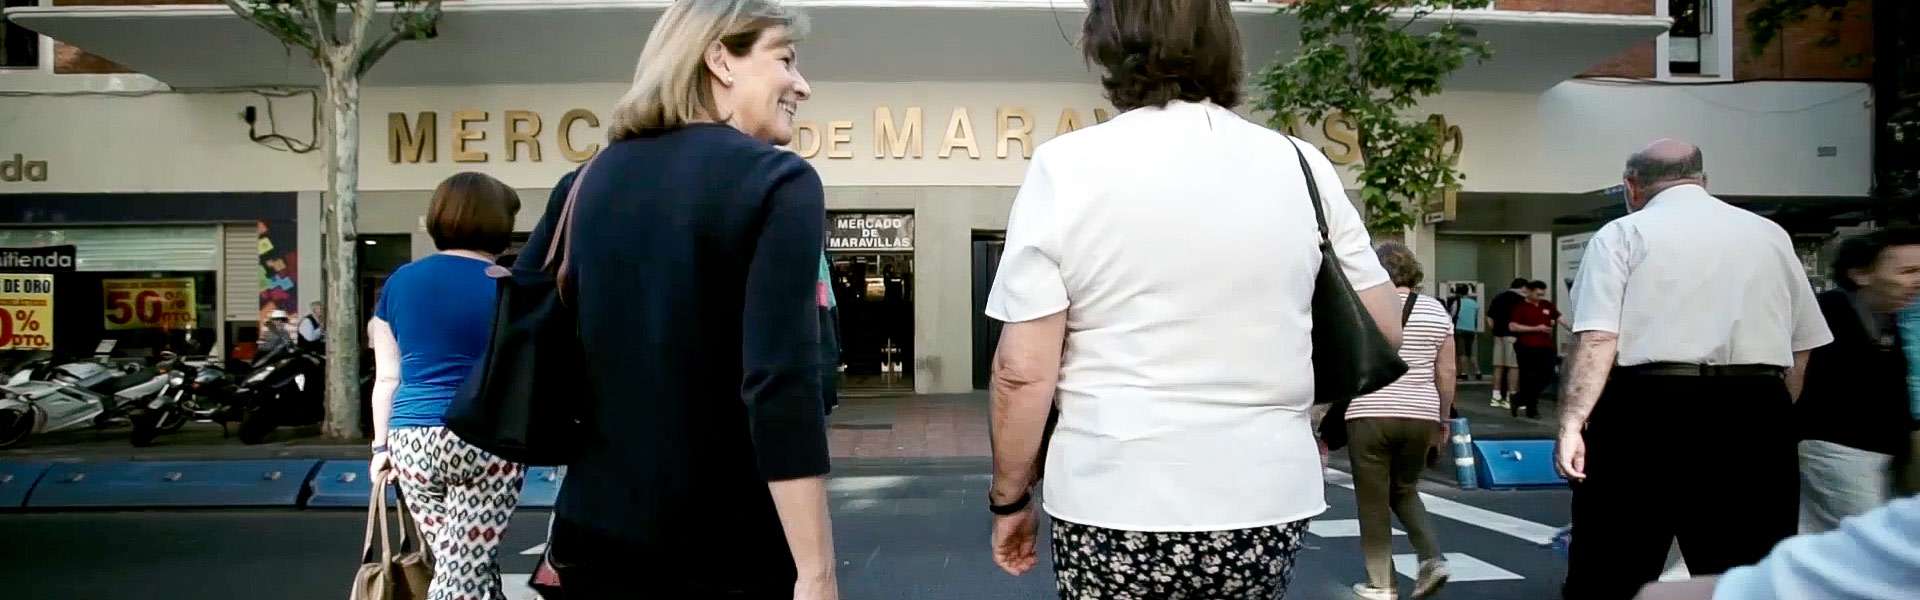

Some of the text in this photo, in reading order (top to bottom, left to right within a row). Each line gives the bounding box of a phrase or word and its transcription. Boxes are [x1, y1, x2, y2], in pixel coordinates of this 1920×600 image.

[387, 108, 600, 163] MERC
[793, 119, 854, 159] DE
[837, 218, 902, 229] MERCADO
[862, 228, 880, 237] DE
[829, 237, 911, 248] MARAVILLAS
[4, 279, 50, 293] DE ORO
[0, 307, 40, 347] 0%
